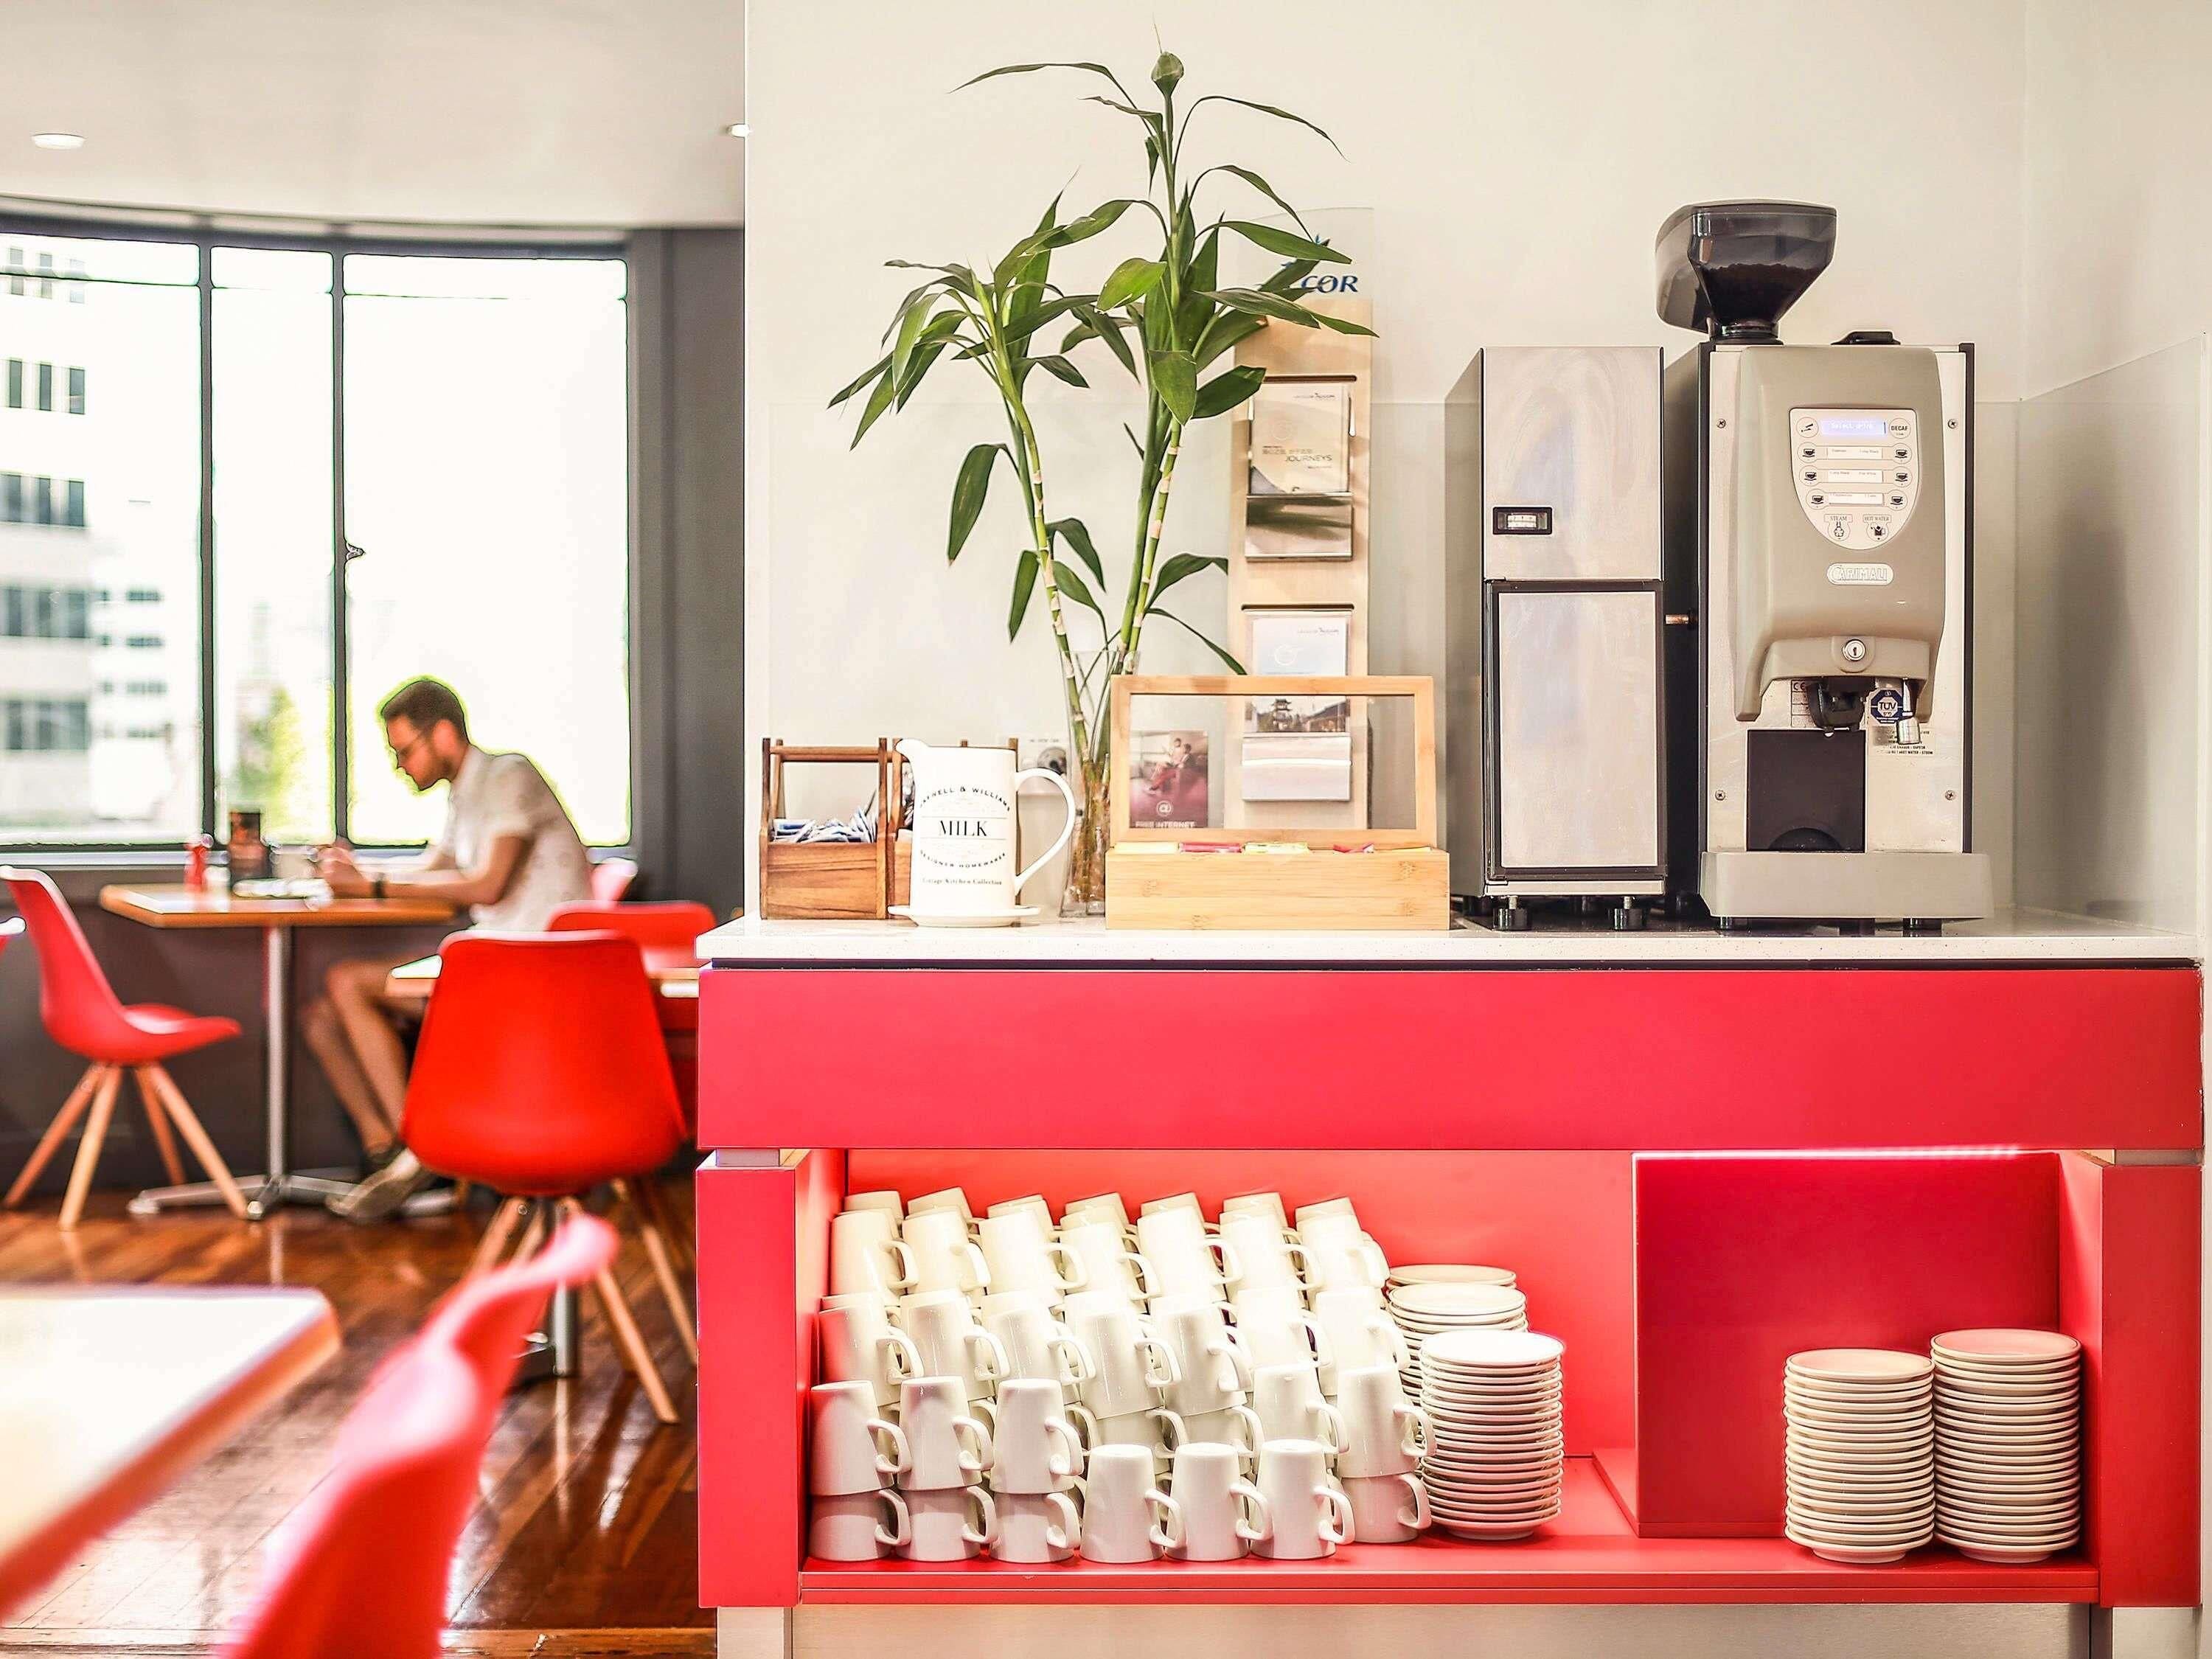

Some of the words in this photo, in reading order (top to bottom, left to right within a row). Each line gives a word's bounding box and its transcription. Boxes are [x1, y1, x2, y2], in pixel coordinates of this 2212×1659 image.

[1298, 274, 1358, 293] COR
[1285, 454, 1333, 462] JOURNEYS
[1831, 565, 1888, 581] CARIMALI
[939, 820, 988, 836] MILK
